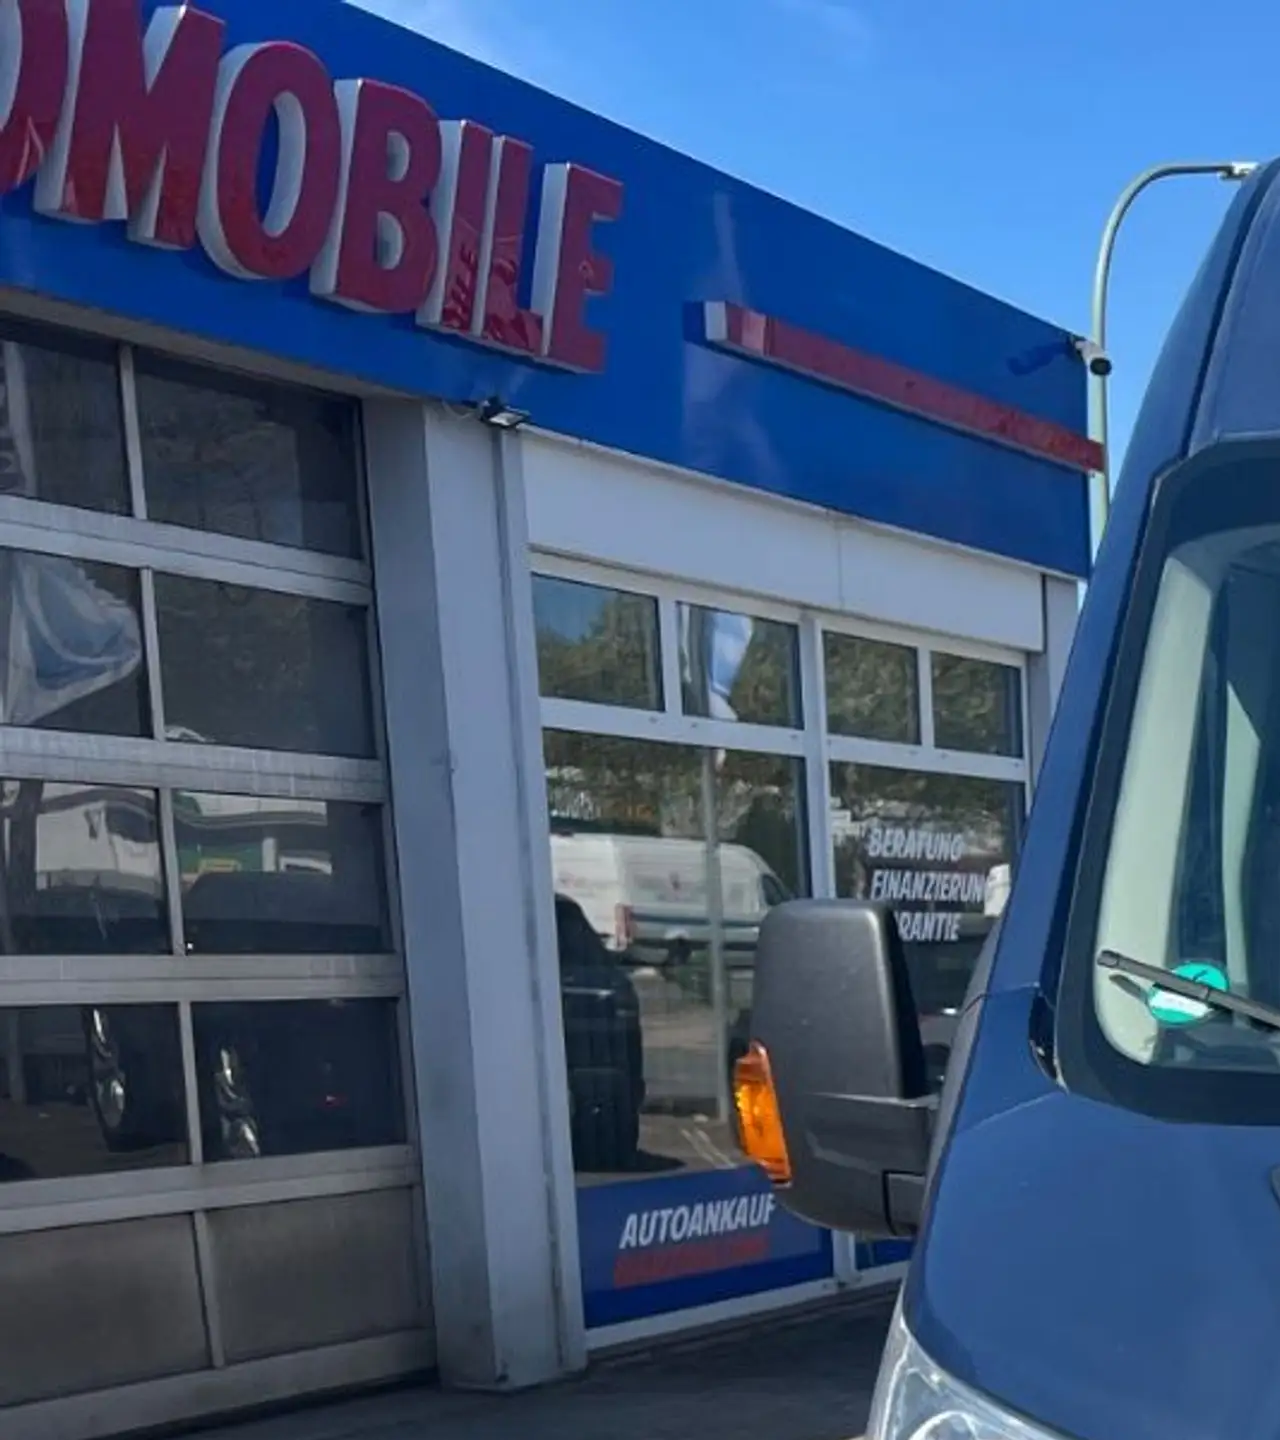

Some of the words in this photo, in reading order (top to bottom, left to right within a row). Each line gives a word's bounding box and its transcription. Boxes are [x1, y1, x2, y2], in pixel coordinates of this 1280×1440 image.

[868, 828, 966, 861] BERATUNG
[894, 910, 961, 942] RANTIE
[618, 1193, 776, 1250] AUTOANKAUF
